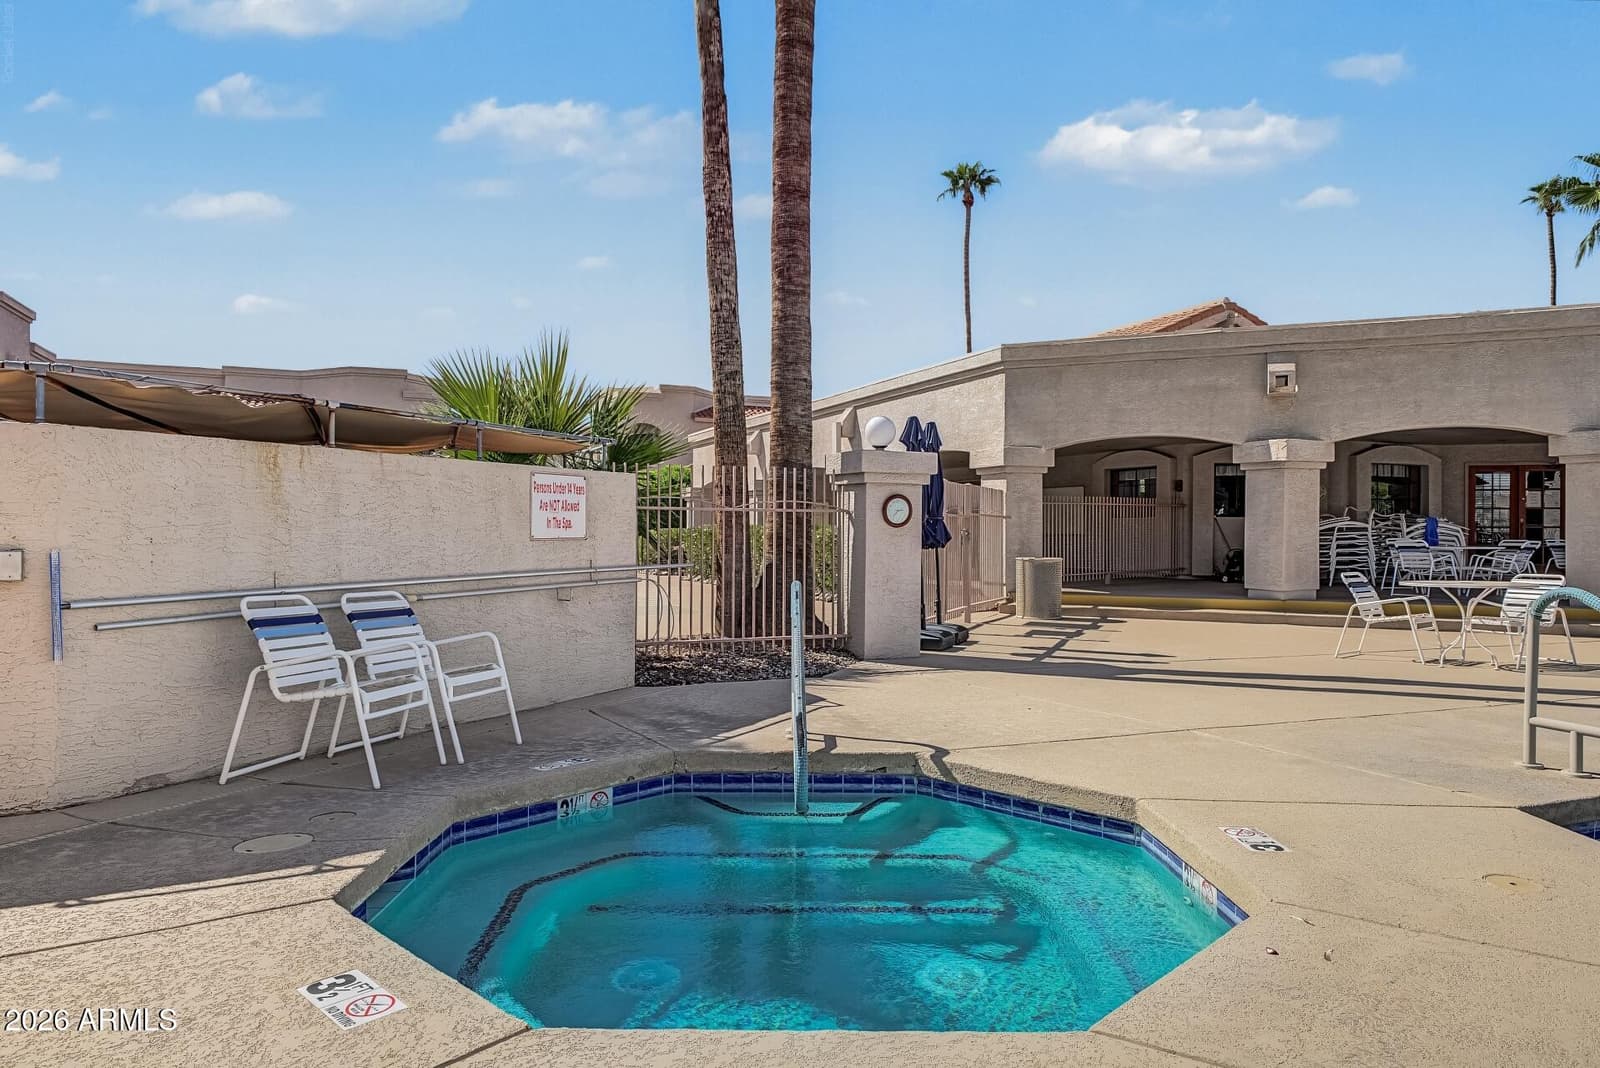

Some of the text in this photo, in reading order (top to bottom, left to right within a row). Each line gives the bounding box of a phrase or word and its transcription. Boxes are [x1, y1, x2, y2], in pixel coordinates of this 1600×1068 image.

[533, 480, 585, 496] Persons Under 14 Years
[539, 499, 580, 512] Are NOT Allowed
[546, 516, 552, 529] In
[552, 516, 561, 529] The
